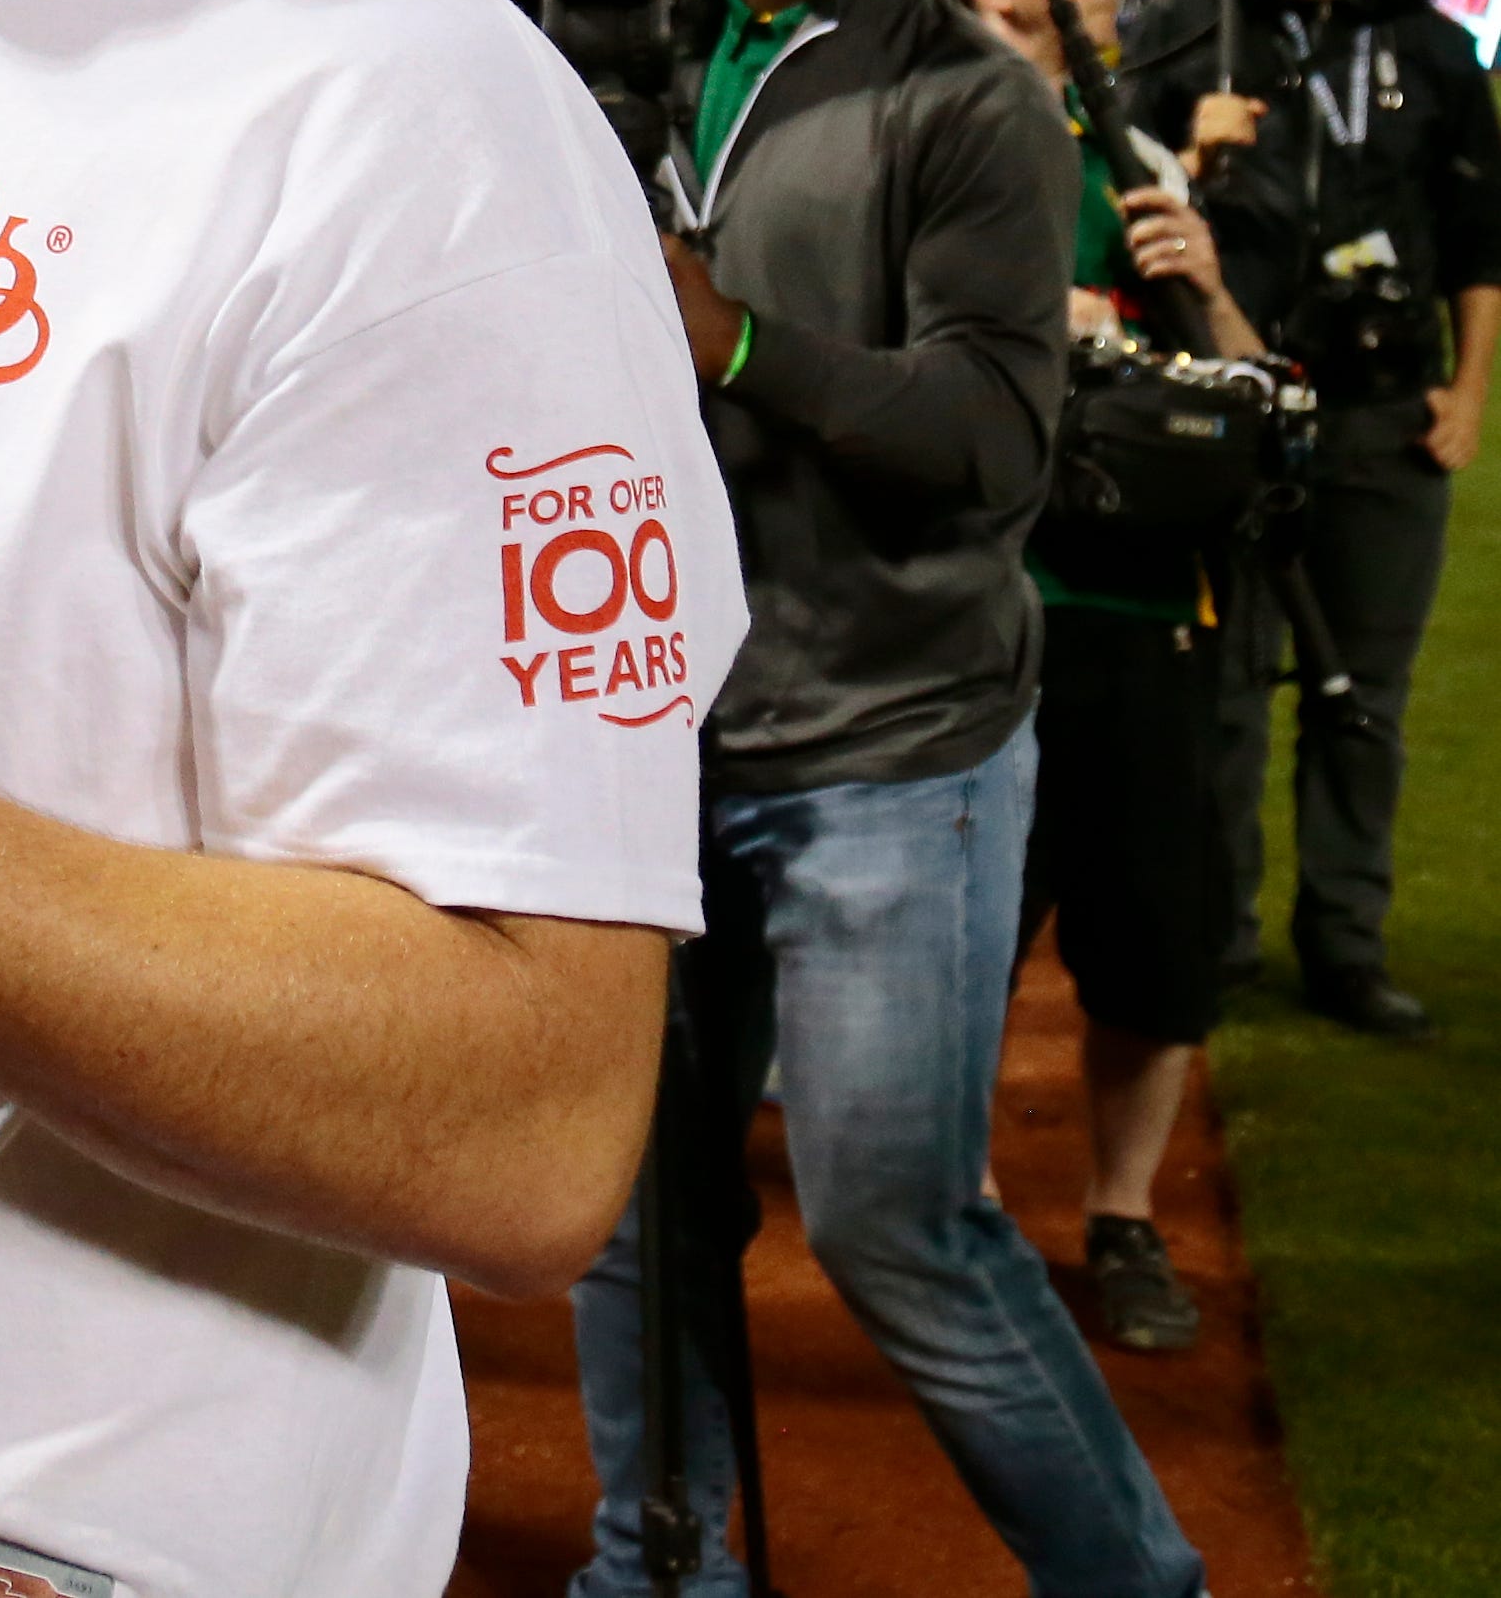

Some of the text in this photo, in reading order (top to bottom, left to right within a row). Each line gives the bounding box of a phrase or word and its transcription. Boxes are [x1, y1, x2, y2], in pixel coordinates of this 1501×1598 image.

[503, 475, 667, 530] FOR OVER
[501, 518, 678, 643] 100
[499, 631, 688, 708] YEARS
